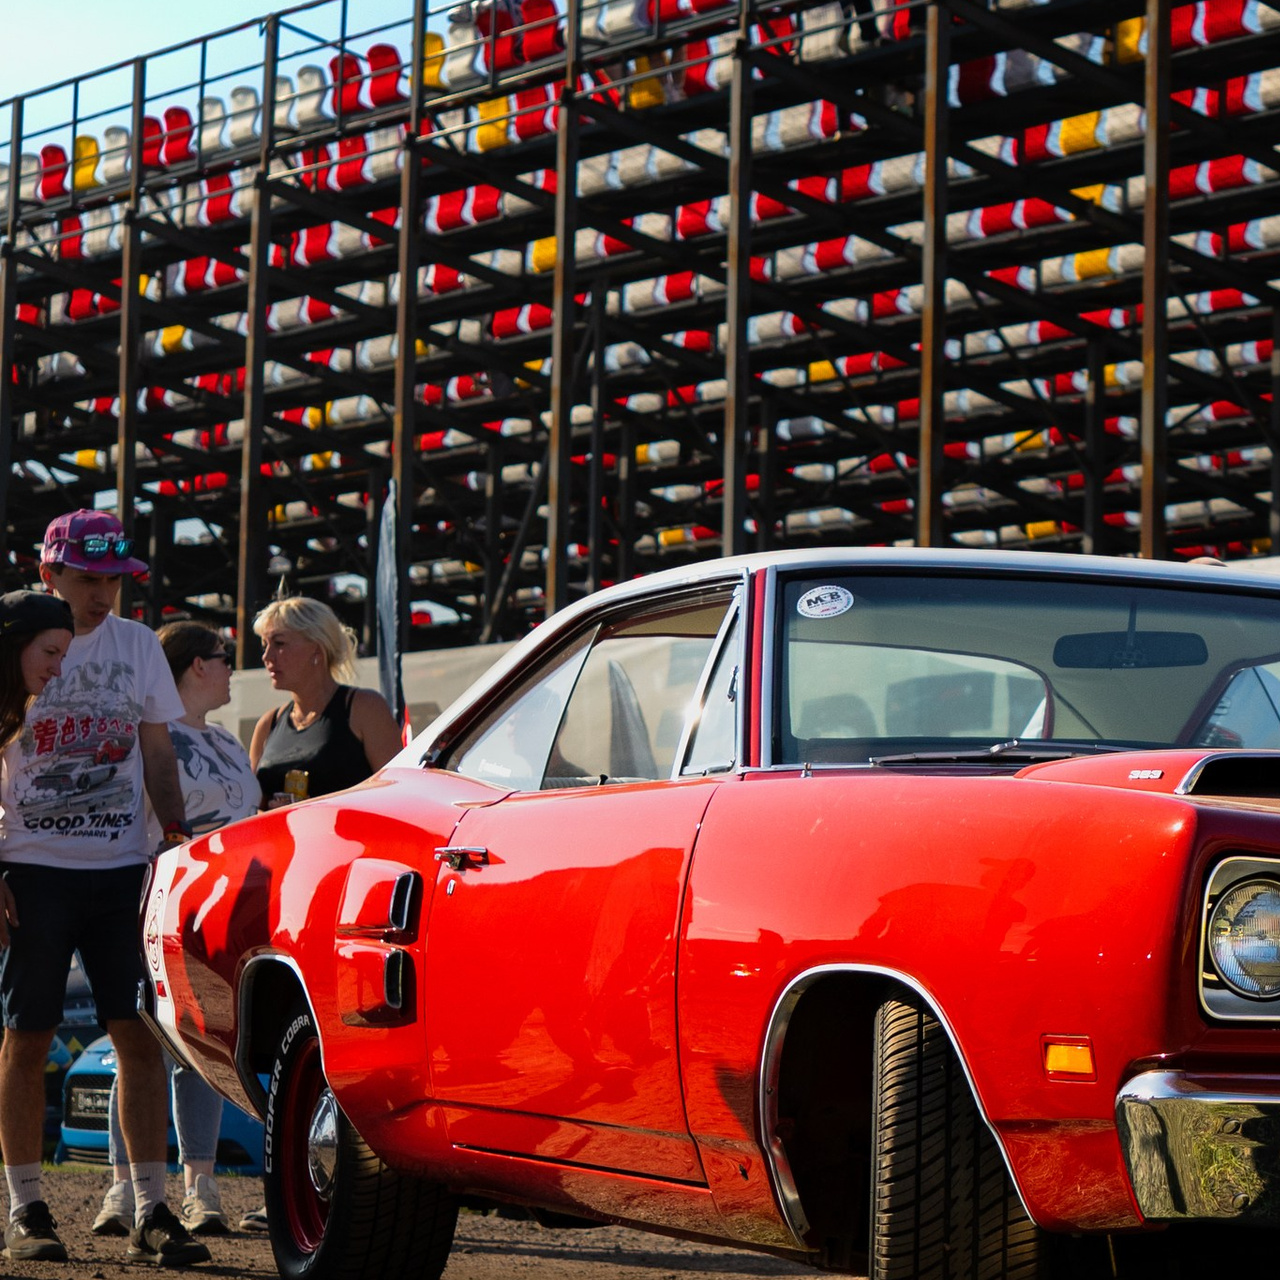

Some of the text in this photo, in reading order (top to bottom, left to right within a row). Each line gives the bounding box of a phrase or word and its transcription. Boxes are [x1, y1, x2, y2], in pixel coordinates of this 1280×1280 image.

[23, 812, 134, 830] GOOD TIMES
[264, 1014, 311, 1173] COOPER COBRA
